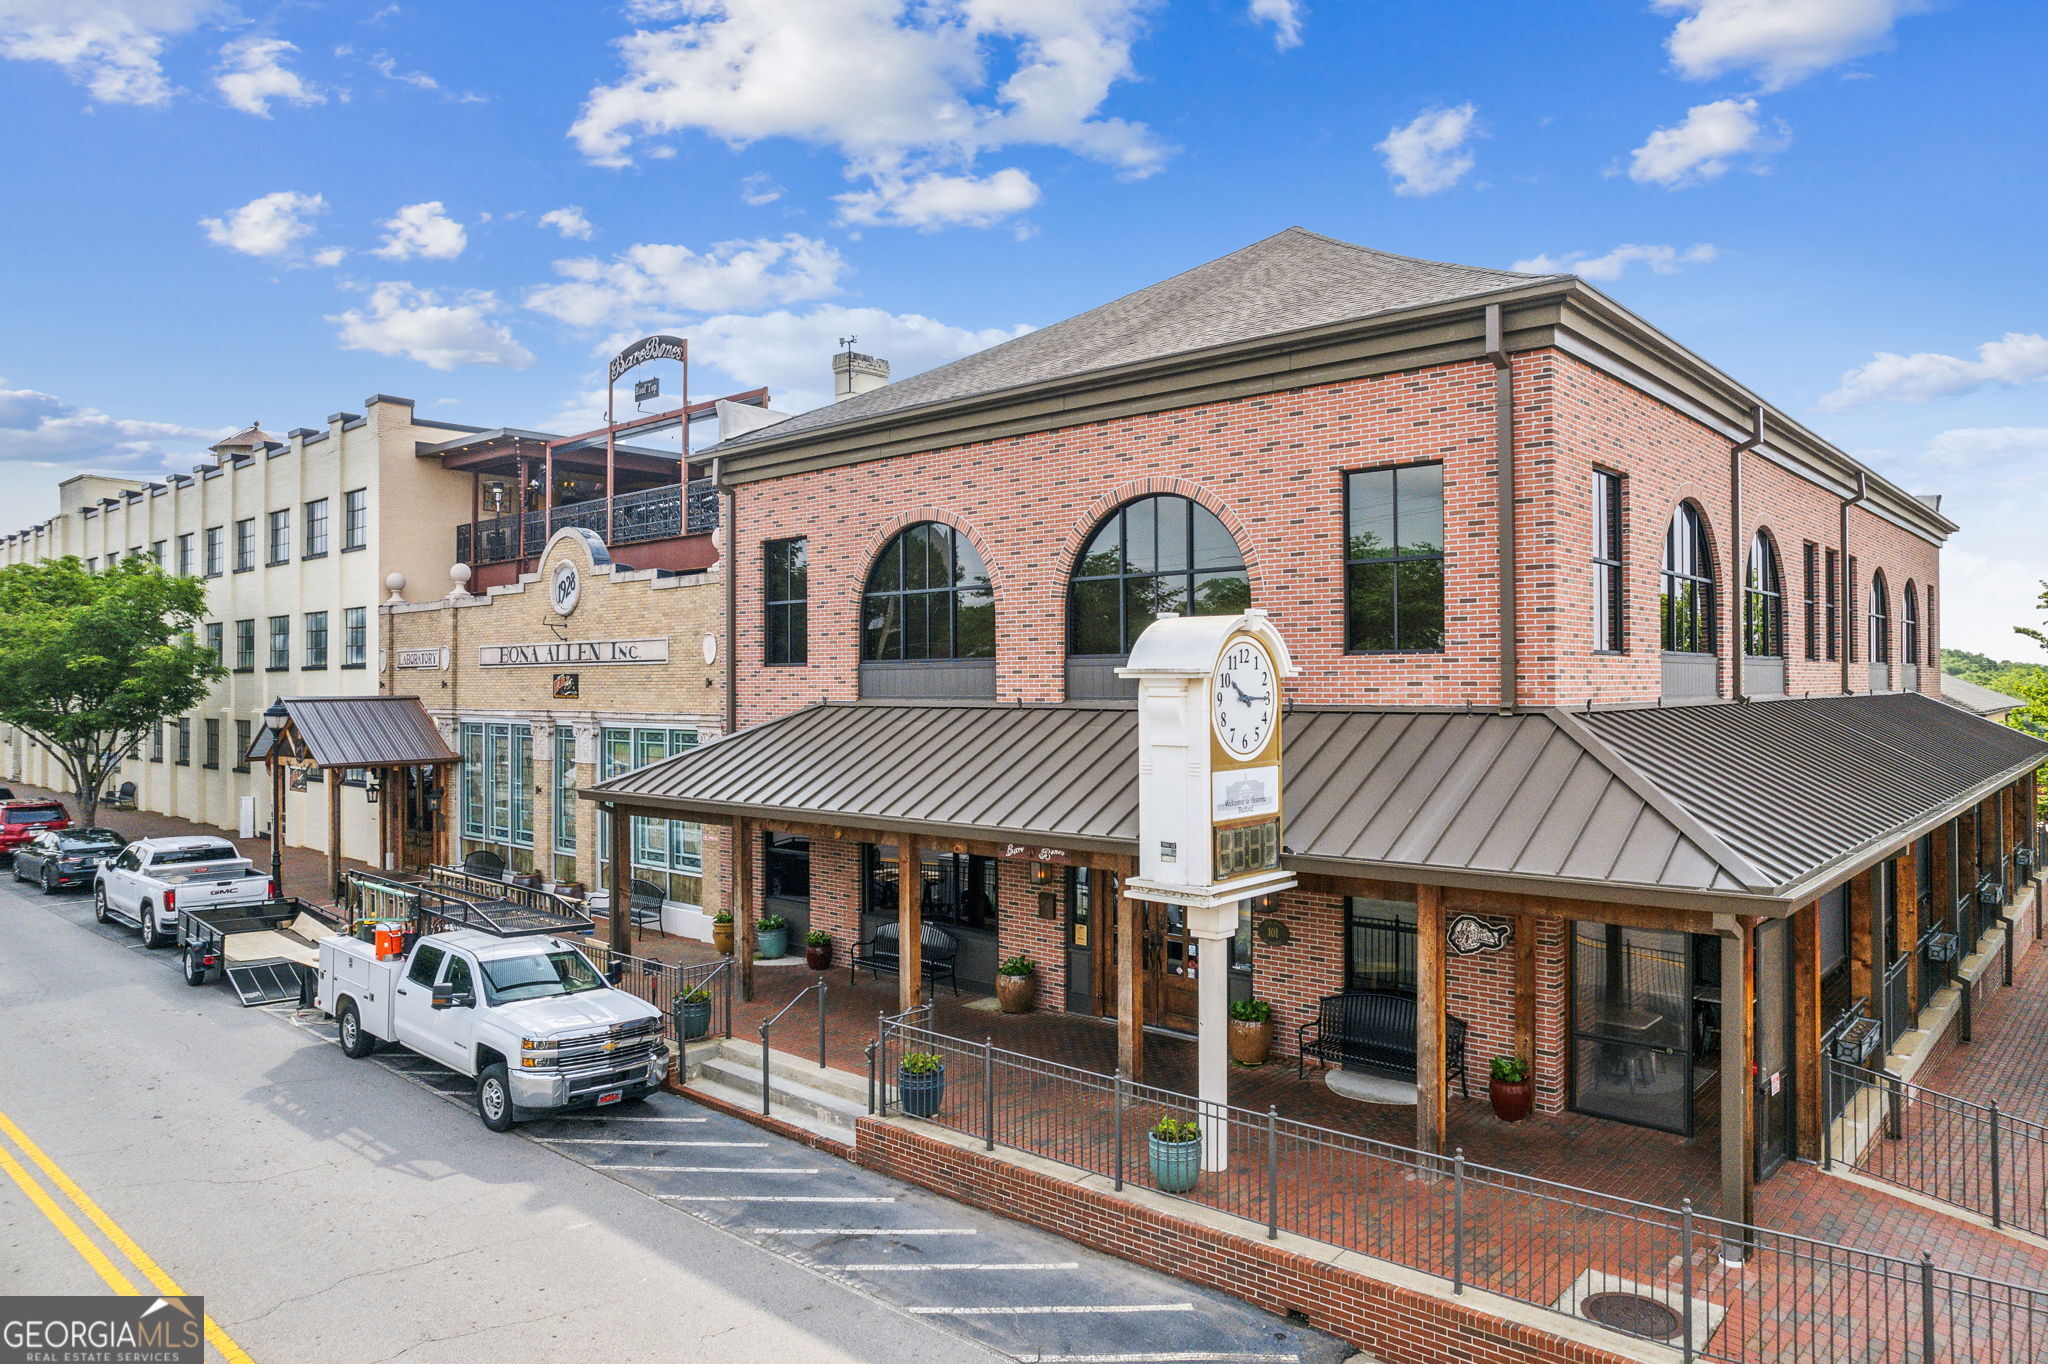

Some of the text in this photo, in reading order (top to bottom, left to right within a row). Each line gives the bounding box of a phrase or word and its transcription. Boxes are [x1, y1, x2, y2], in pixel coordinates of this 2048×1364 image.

[611, 336, 683, 379] Bare Bones
[645, 382, 657, 394] Top
[557, 571, 576, 604] 1928
[398, 652, 437, 666] LABORATORY
[499, 646, 539, 664] BONA
[546, 642, 601, 662] ALLEN
[1239, 648, 1250, 663] 12
[1228, 655, 1238, 670] 11
[1253, 655, 1259, 670] 1
[1220, 672, 1231, 688] 10
[1261, 672, 1267, 686] 2
[1217, 692, 1223, 707] 9
[1265, 691, 1270, 705] 3
[1220, 712, 1227, 727] 8
[1261, 711, 1267, 725] 4
[1229, 727, 1236, 743] 7
[1242, 733, 1248, 749] 6
[1254, 726, 1260, 742] 5
[1268, 927, 1279, 938] 101
